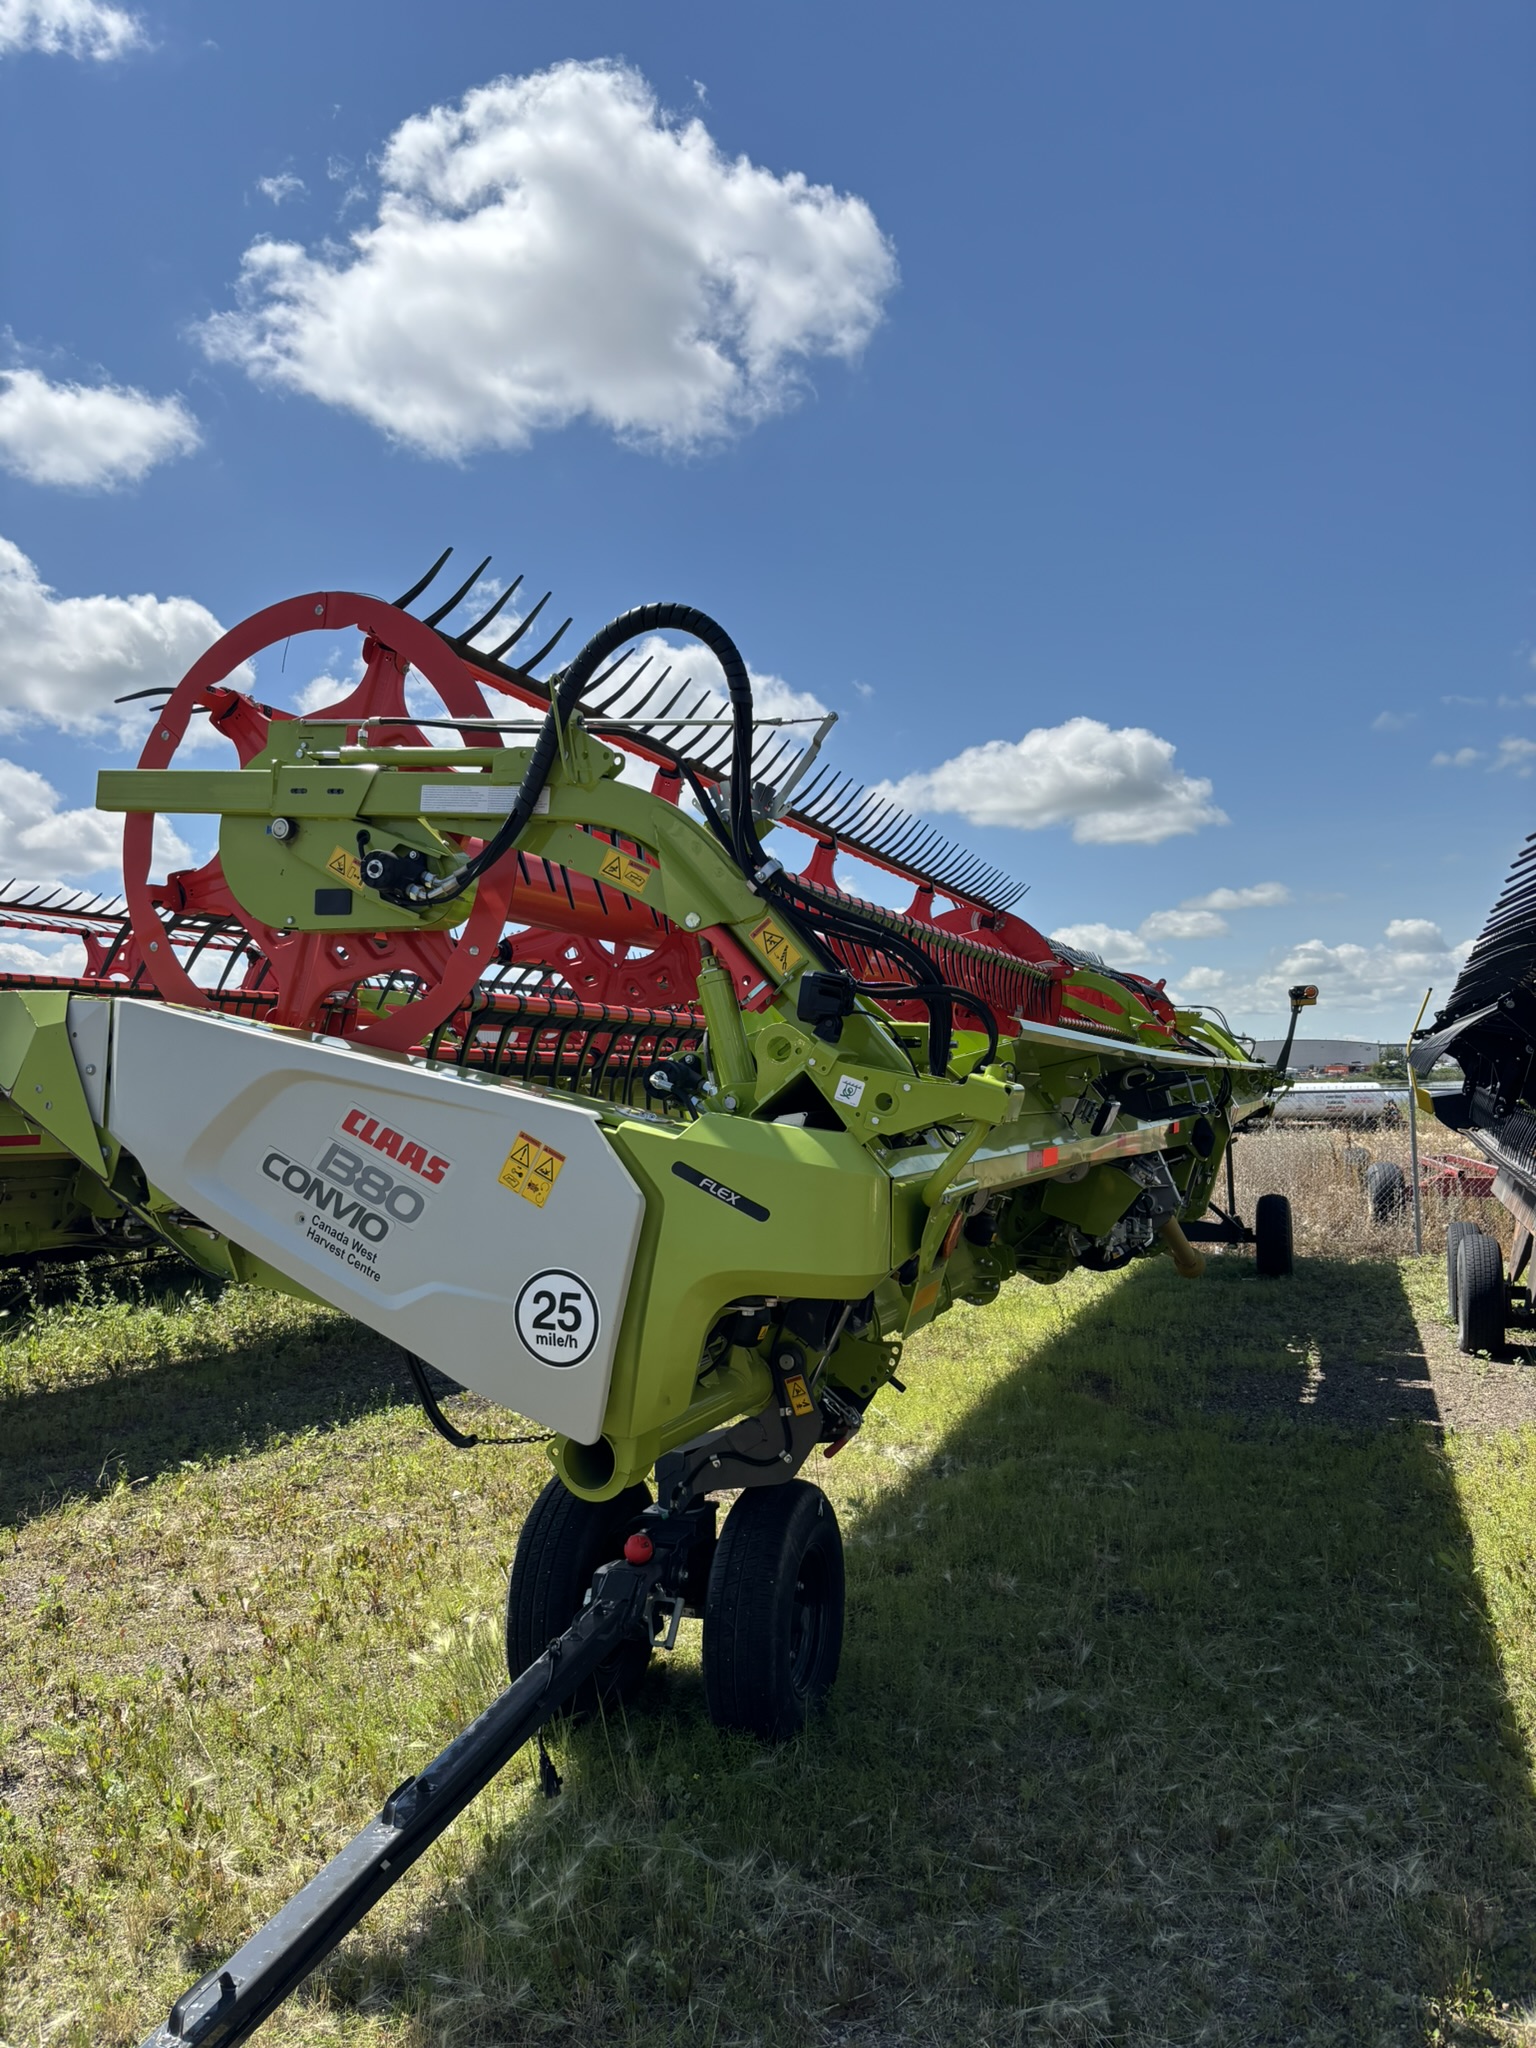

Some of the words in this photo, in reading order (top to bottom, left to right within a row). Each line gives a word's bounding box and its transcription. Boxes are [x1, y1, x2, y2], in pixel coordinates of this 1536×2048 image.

[341, 1109, 450, 1184] CLAAS
[262, 1153, 389, 1242] CONVIO
[699, 1178, 741, 1206] FLEX
[306, 1226, 346, 1259] Harvest
[346, 1253, 381, 1282] Centre
[311, 1214, 349, 1246] Canada
[351, 1239, 378, 1263] West
[532, 1290, 582, 1332] 25
[535, 1333, 578, 1349] mile/h
